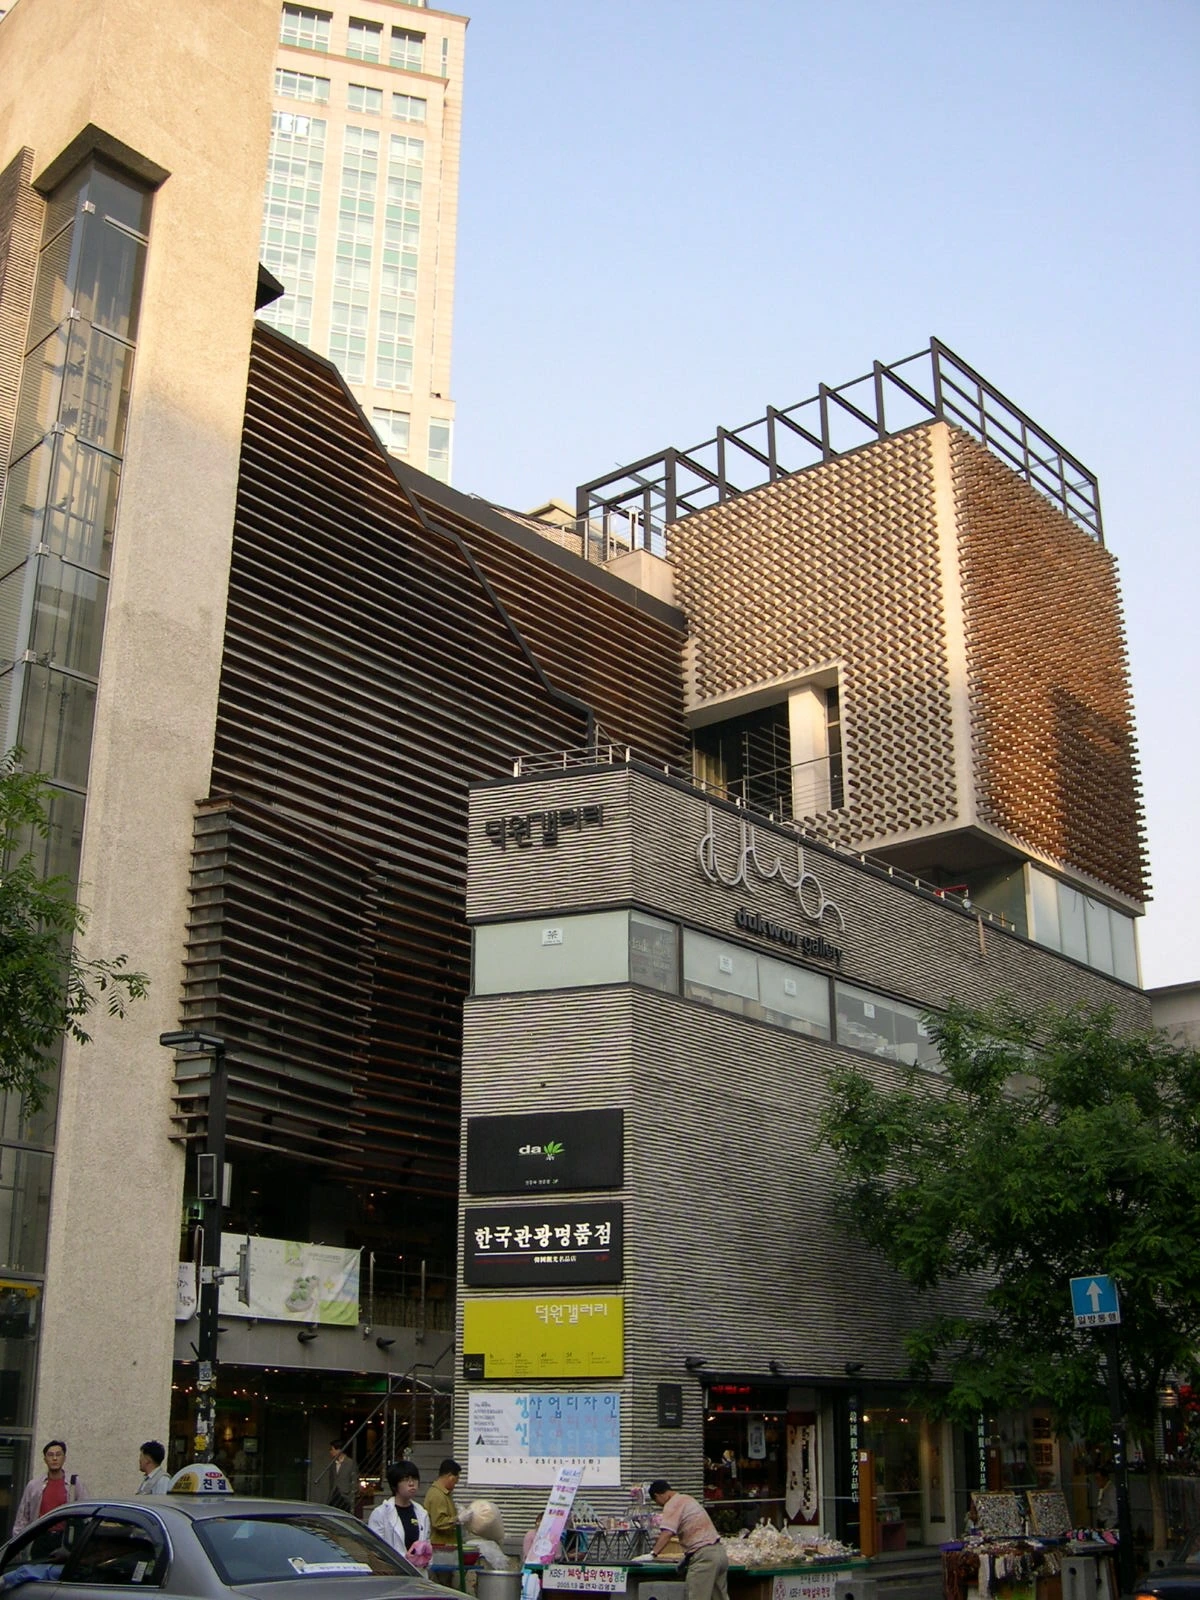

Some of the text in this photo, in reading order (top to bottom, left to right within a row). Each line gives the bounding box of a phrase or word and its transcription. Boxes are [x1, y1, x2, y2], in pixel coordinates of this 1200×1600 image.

[485, 804, 604, 852] 덕원갤러리
[735, 907, 843, 970] dukwon gallery
[474, 1221, 612, 1250] 한국관광명품점
[535, 1303, 609, 1325] 덕원갤러리
[1077, 1313, 1117, 1325] 일방통행
[529, 1396, 618, 1419] 산업디자인
[203, 1478, 227, 1490] 친절
